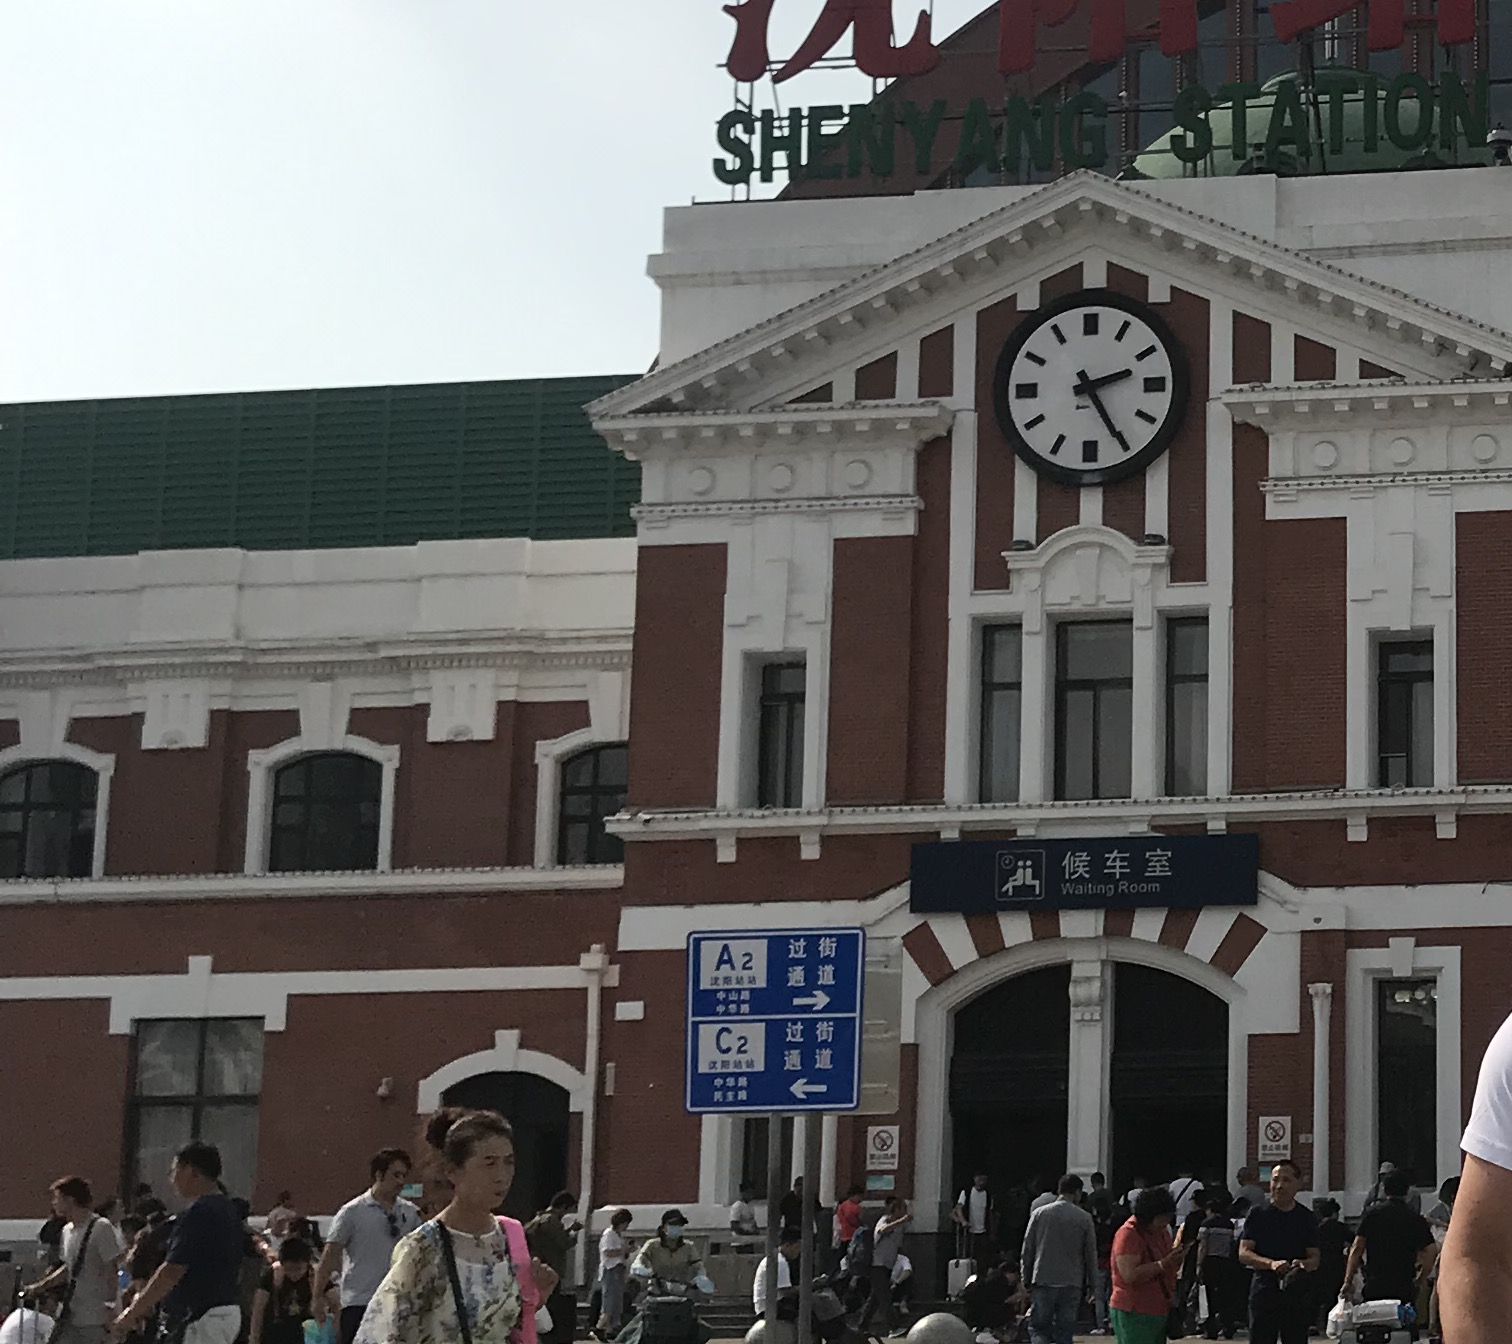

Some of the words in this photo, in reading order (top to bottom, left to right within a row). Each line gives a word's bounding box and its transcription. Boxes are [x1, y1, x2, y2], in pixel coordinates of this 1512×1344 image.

[712, 91, 1108, 185] SHENYANG
[1170, 69, 1489, 164] STATION
[1061, 848, 1173, 881] 候车室
[1061, 881, 1114, 897] Waiting
[1118, 880, 1161, 894] Room
[787, 937, 837, 958] 过街
[786, 964, 836, 987] 通道
[785, 1021, 835, 1043] 过街
[783, 1048, 834, 1070] 通道
